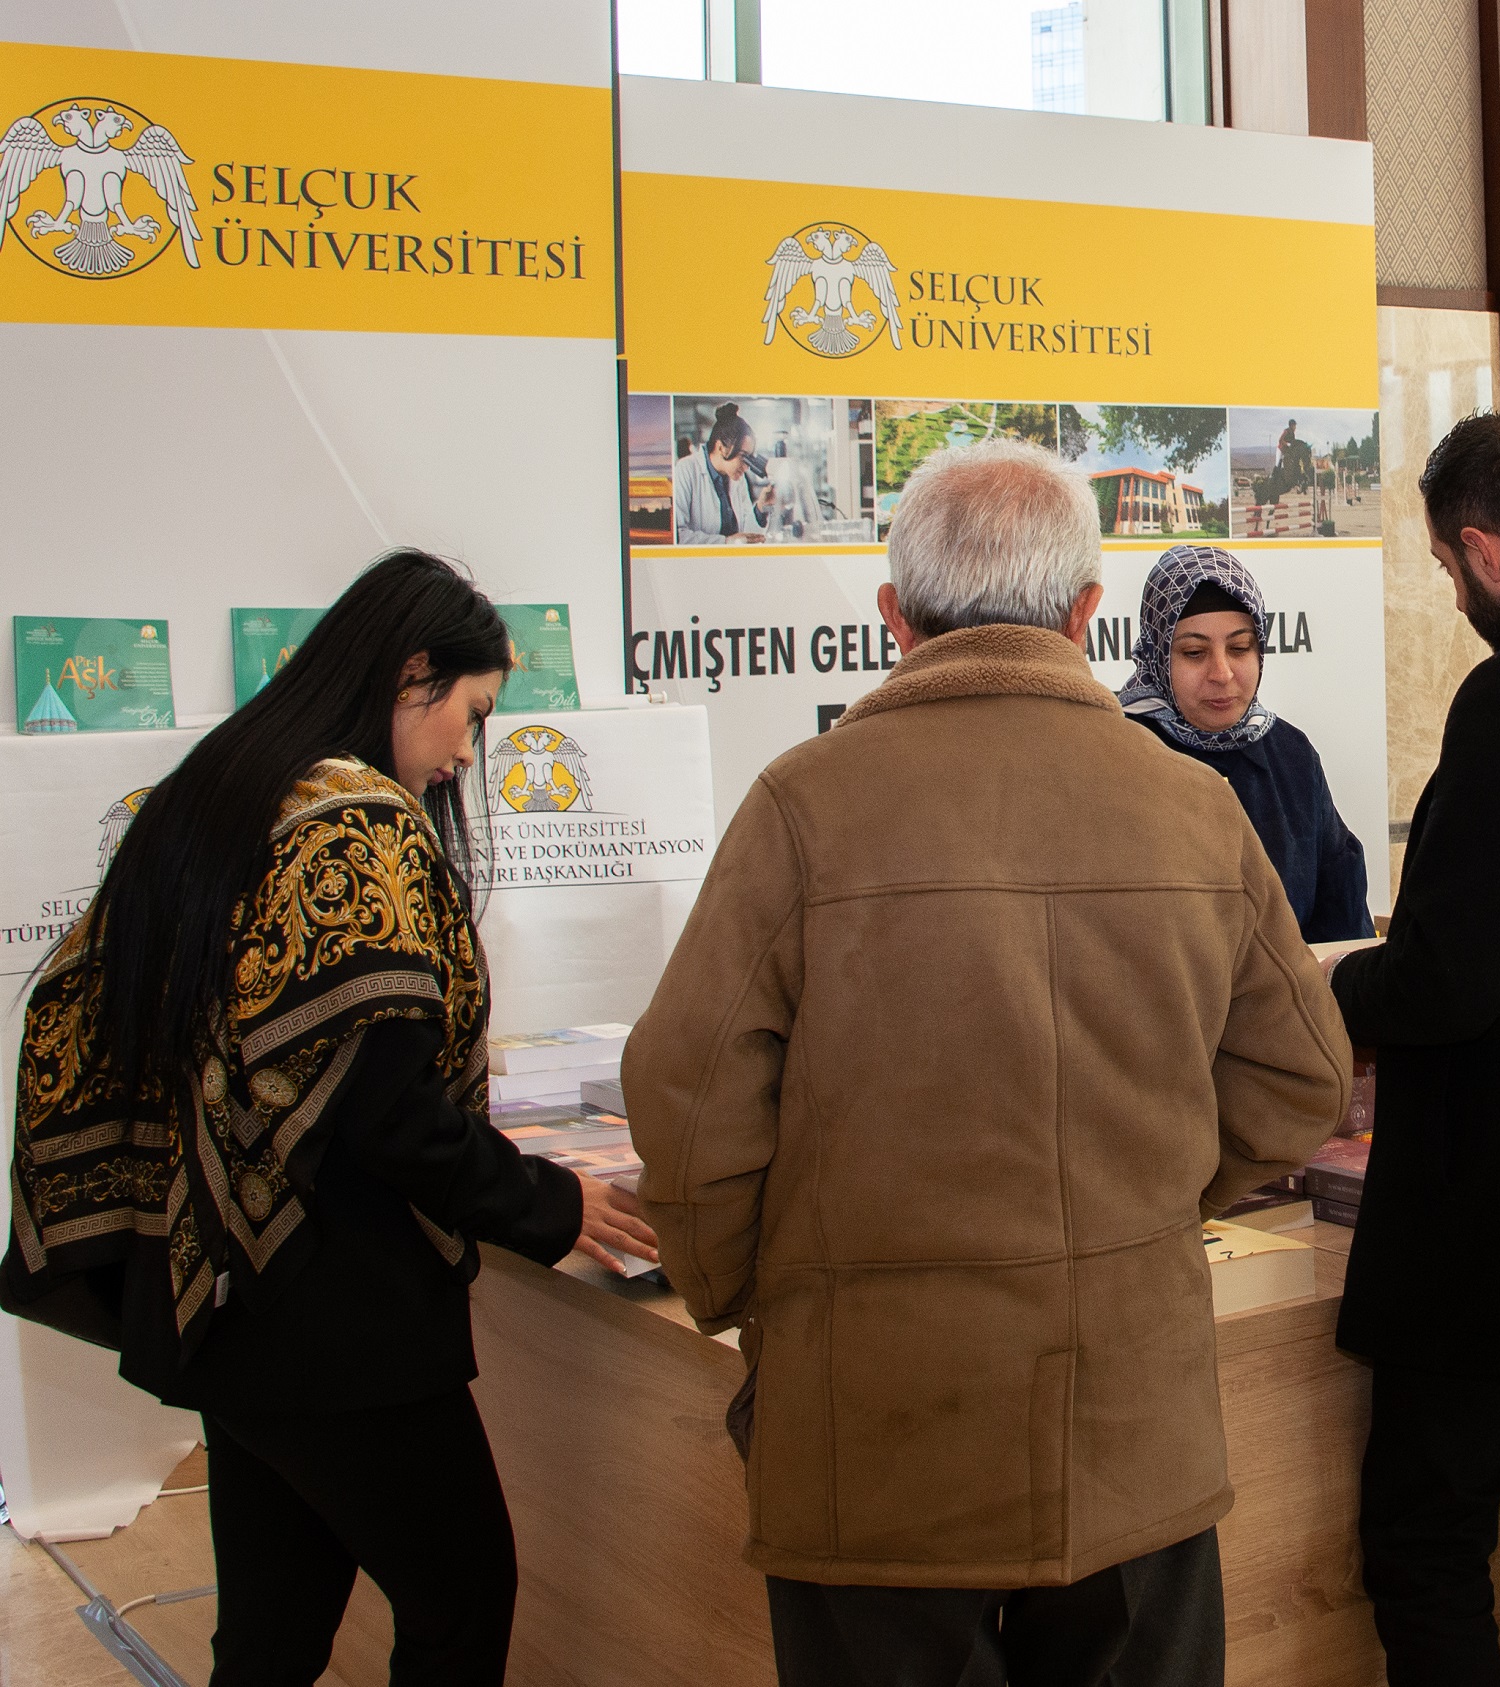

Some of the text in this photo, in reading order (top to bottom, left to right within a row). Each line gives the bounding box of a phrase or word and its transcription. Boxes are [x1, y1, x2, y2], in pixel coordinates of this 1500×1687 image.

[212, 161, 421, 219] SELÇUK
[212, 217, 586, 281] ÜNİVERSİTESİ
[909, 269, 1044, 313] SELÇUK
[909, 311, 1153, 358] ÜNİVERSİTESİ
[632, 615, 796, 694] ÇMİŞTEN
[810, 624, 897, 673] GELE
[57, 656, 118, 700] Aşk
[504, 846, 528, 861] VE
[533, 838, 705, 860] DOKÜMANTASYON
[518, 818, 647, 840] ÜNİVERSİTESİ
[523, 860, 634, 884] BAŞKANLIĞI
